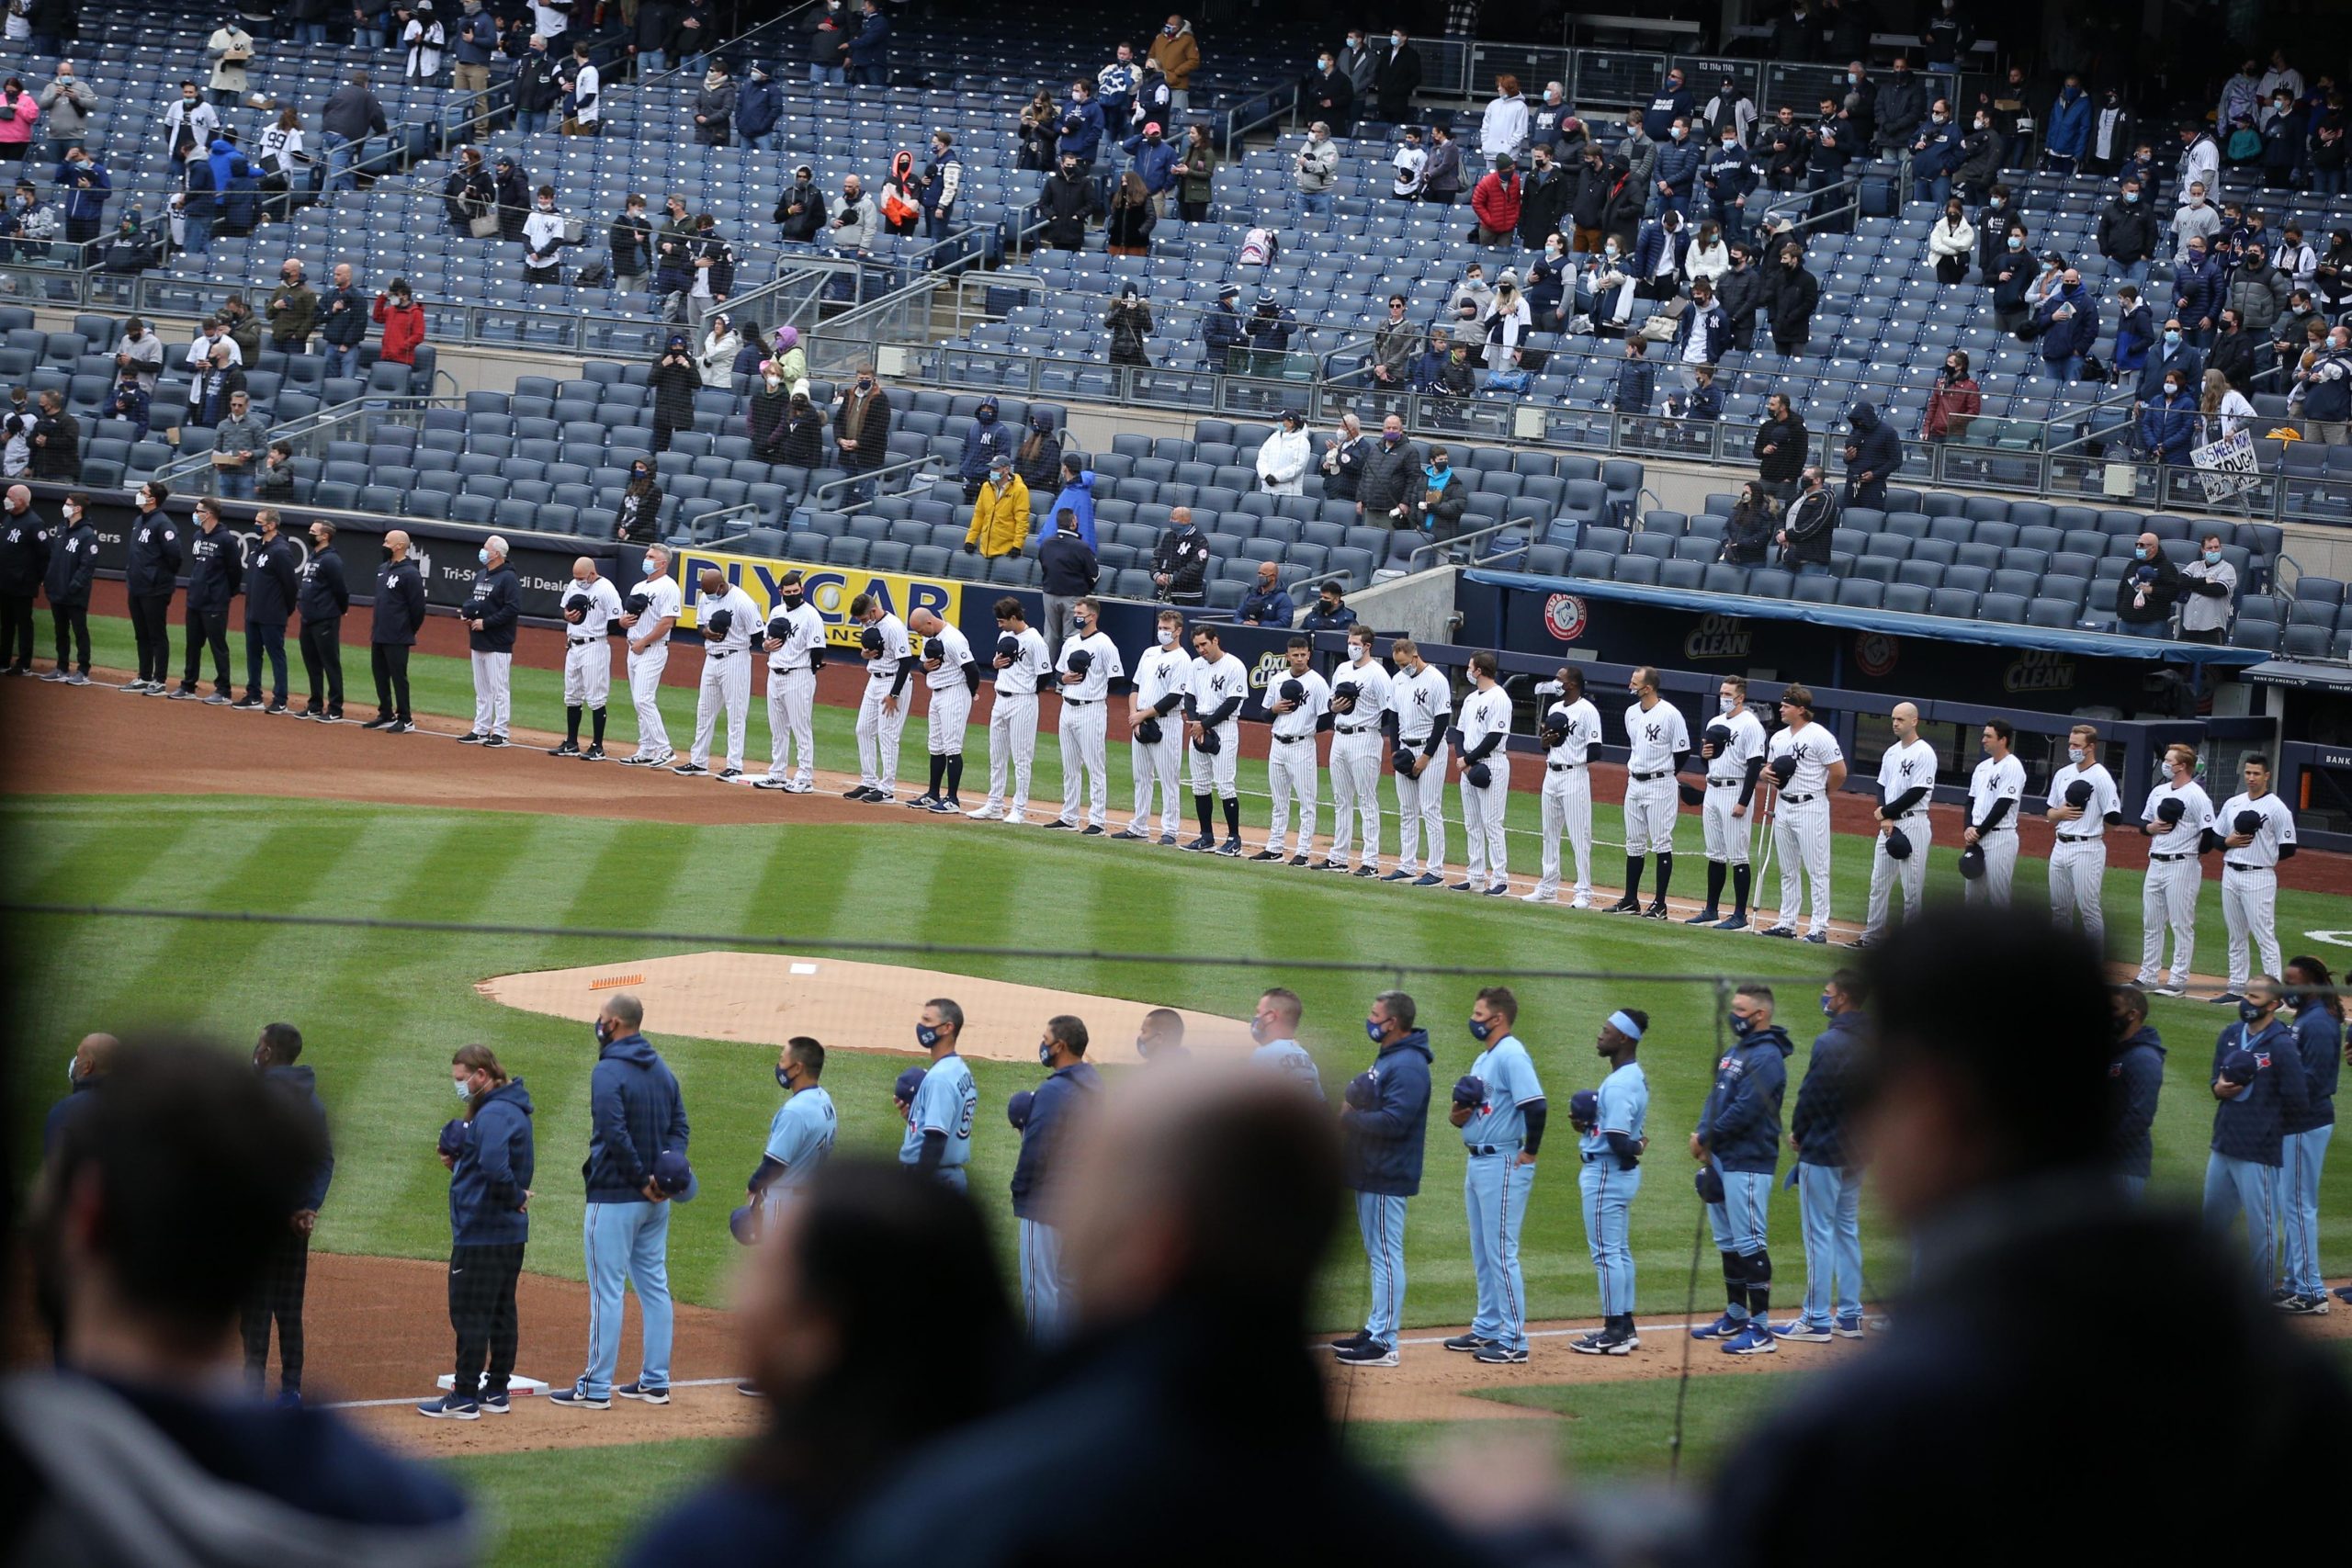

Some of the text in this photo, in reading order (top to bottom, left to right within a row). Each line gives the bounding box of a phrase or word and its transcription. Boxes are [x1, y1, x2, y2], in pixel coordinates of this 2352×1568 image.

[1699, 62, 1708, 71] 113
[267, 131, 287, 149] 99
[1687, 631, 1749, 656] CLEAN
[1261, 654, 1287, 671] OXI
[2325, 755, 2352, 765] BANK
[922, 1032, 935, 1043] 53
